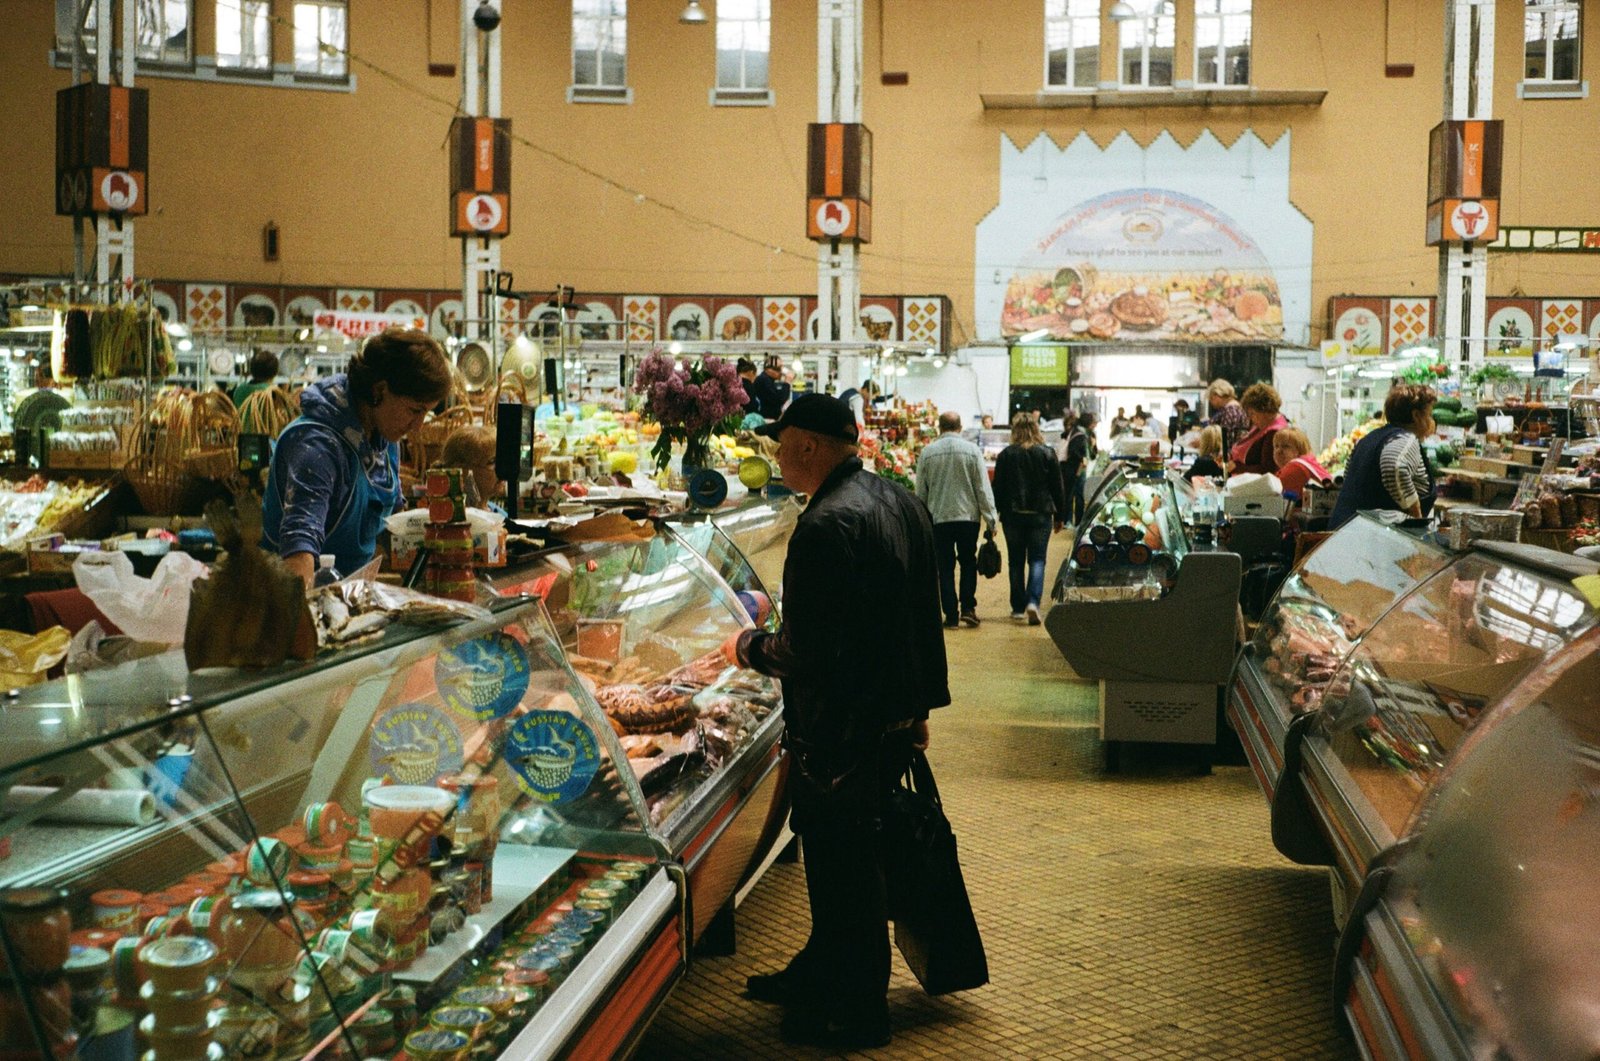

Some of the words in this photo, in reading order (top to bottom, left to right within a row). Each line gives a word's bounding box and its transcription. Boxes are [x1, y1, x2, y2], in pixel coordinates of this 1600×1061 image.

[1023, 358, 1056, 368] FRESH
[386, 711, 428, 729] RUSSIAN
[524, 715, 567, 730] RUSSIAN
[572, 723, 594, 760] CAVIAR
